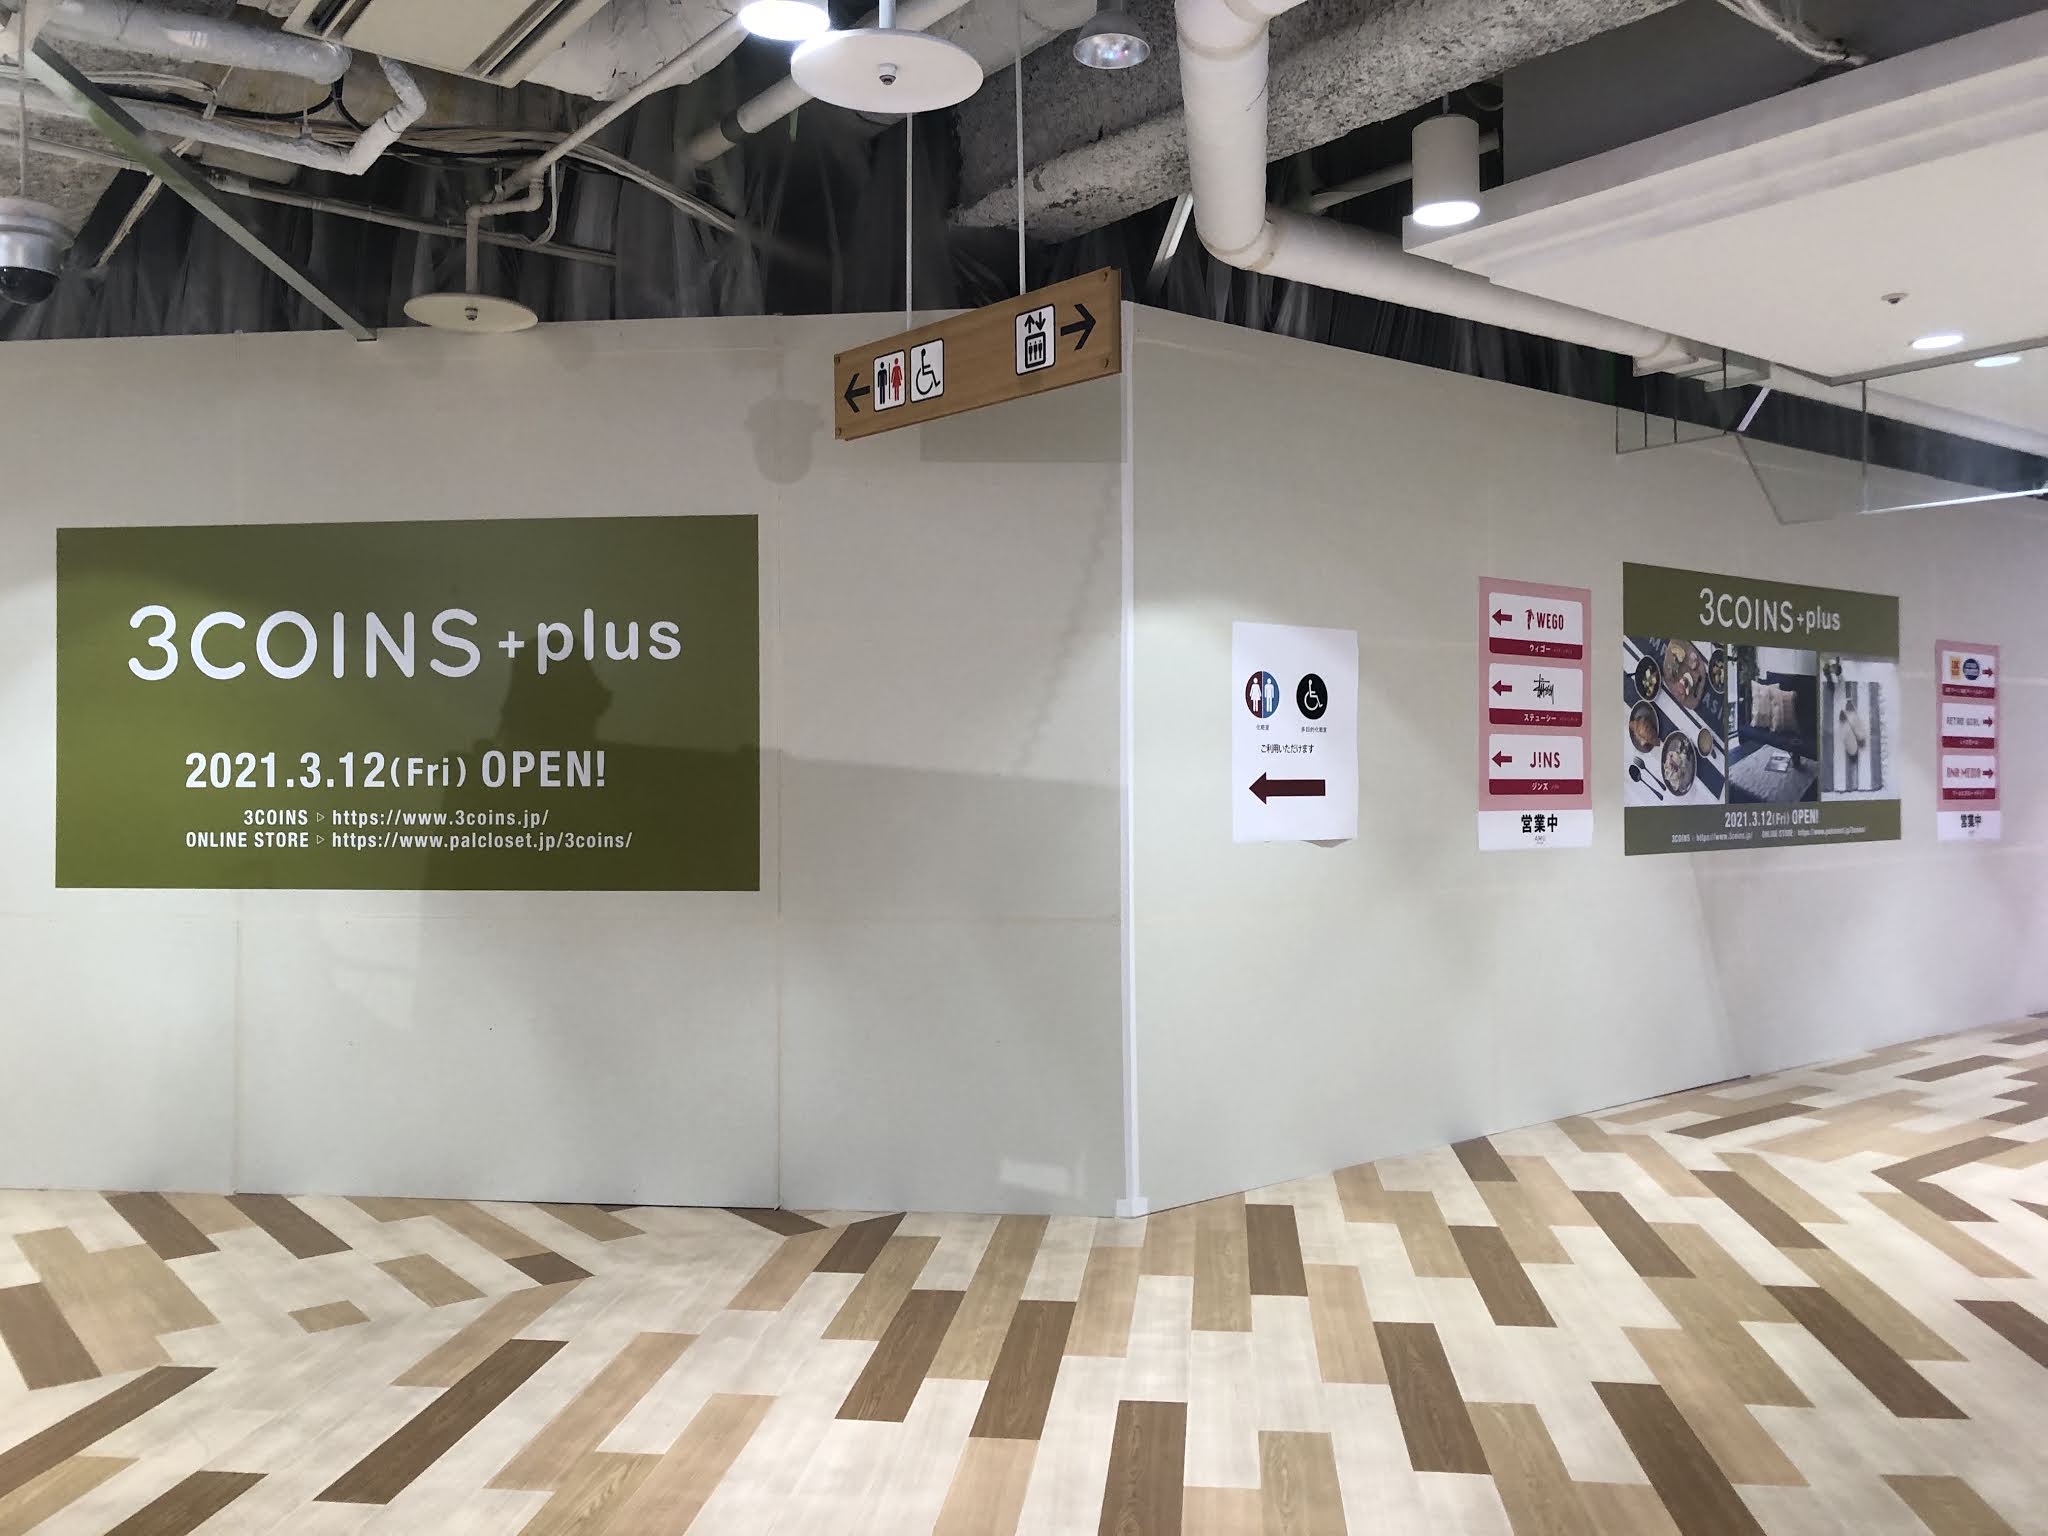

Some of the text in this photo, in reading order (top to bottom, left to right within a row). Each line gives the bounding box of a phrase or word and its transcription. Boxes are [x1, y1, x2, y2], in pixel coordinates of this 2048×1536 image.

[1699, 587, 1794, 634] 3COINS
[1536, 611, 1564, 631] WEGO
[128, 604, 482, 682] 3COINS
[1529, 644, 1551, 653] ウィゴー
[1524, 713, 1557, 723] ステューシー
[1261, 743, 1315, 754] ご利用いただけます
[185, 750, 606, 790] 2021.3.12(Fri) OPEN!
[1531, 782, 1549, 791] ジンズ
[243, 808, 549, 829] 3COINS https://www.3coins.jp/
[1520, 813, 1558, 834] 営業中
[1724, 809, 1819, 828] 2021.3.12(Fri) OPEN!
[186, 831, 633, 851] ONLINE STORE https://www.palcloset.jp/3coins/
